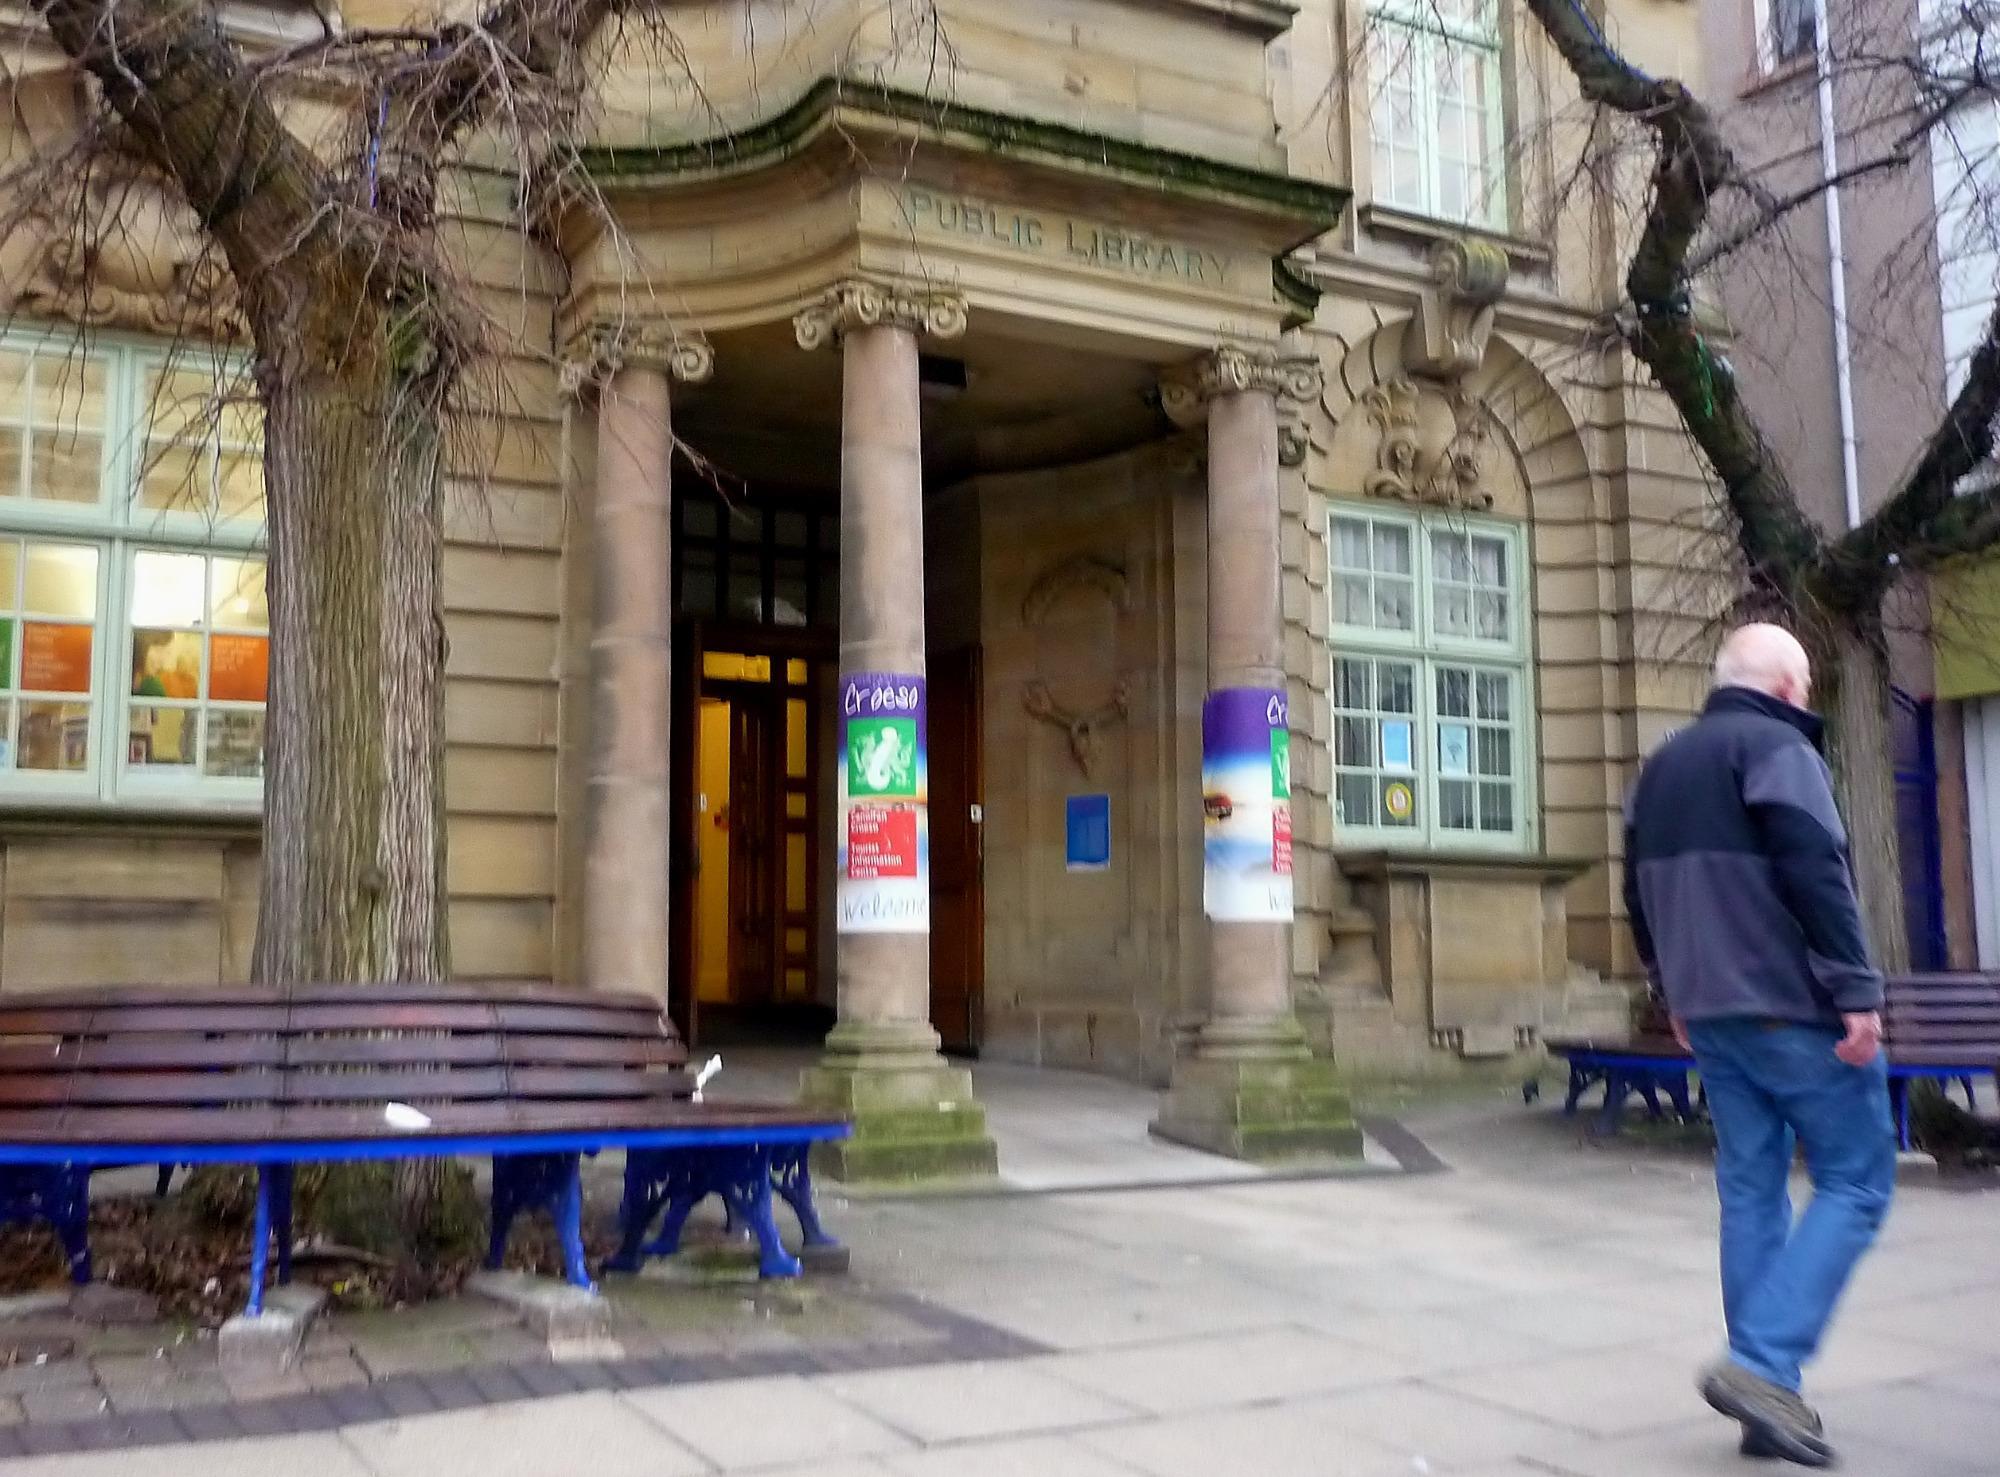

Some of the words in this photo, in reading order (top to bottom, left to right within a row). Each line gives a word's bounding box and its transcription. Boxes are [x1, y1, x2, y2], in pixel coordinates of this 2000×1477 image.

[908, 188, 1043, 249] PUBLIC
[1066, 219, 1233, 285] LIBRARY
[845, 682, 918, 716] Croeso
